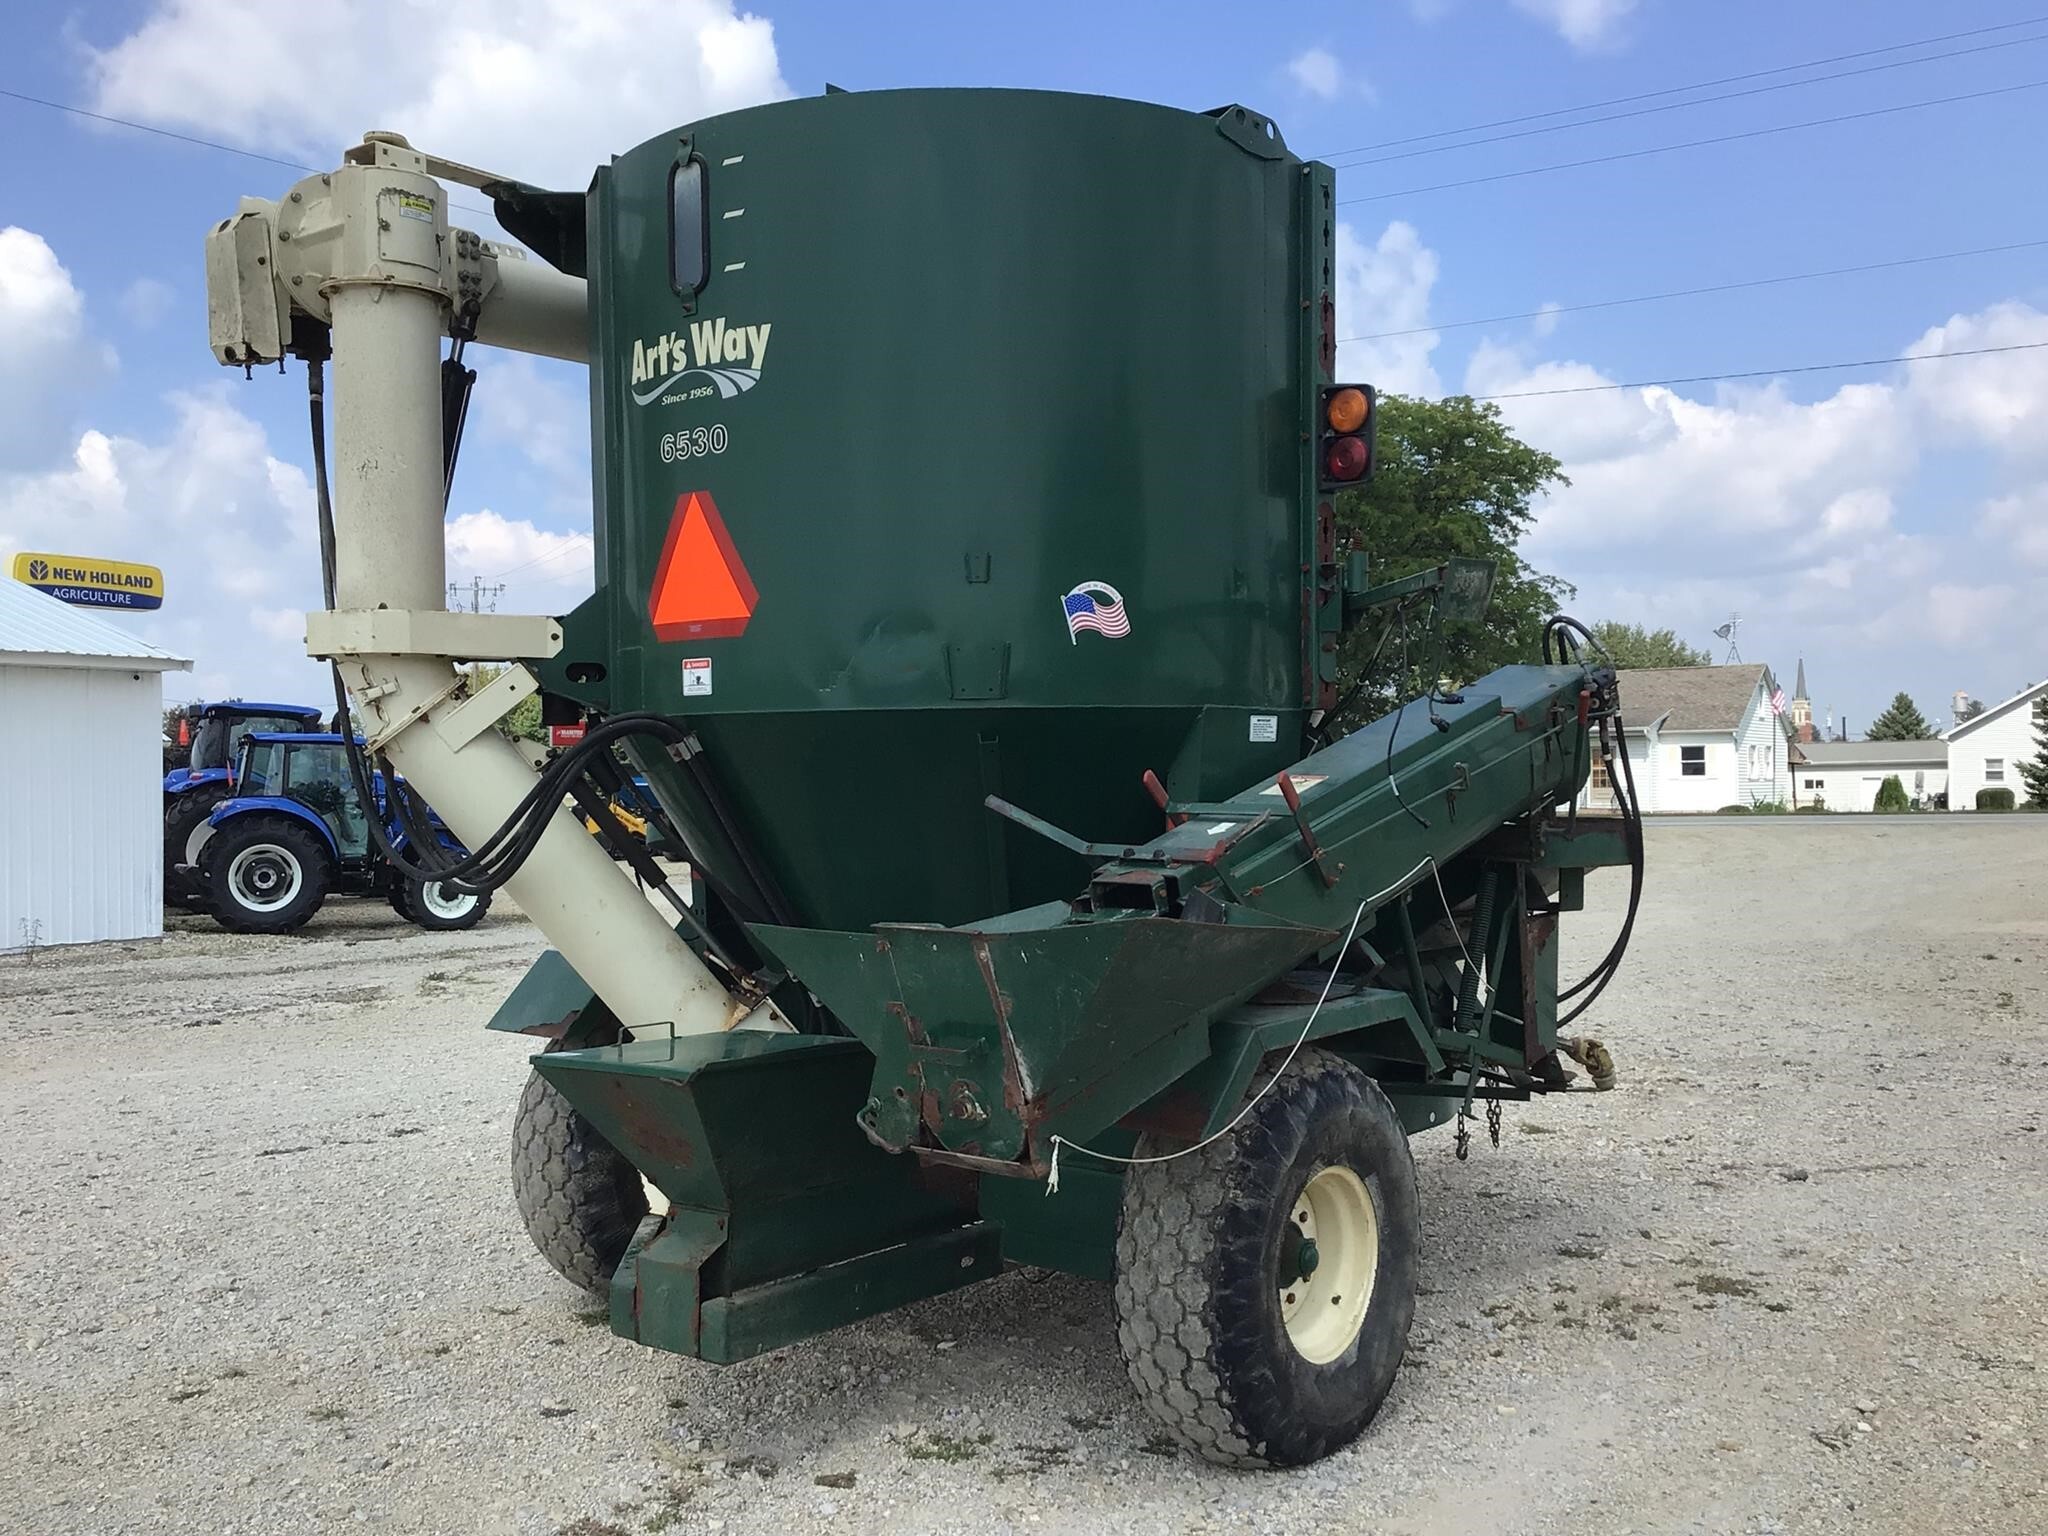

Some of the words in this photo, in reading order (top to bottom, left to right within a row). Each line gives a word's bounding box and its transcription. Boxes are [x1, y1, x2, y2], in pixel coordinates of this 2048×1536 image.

[631, 331, 688, 386] Art's
[690, 317, 772, 370] Way
[661, 393, 687, 406] Since
[689, 385, 714, 400] 1956
[660, 423, 728, 463] 6530
[53, 567, 86, 582] NEW
[90, 571, 153, 588] HOLLAND
[53, 587, 131, 604] AGRICULTURE
